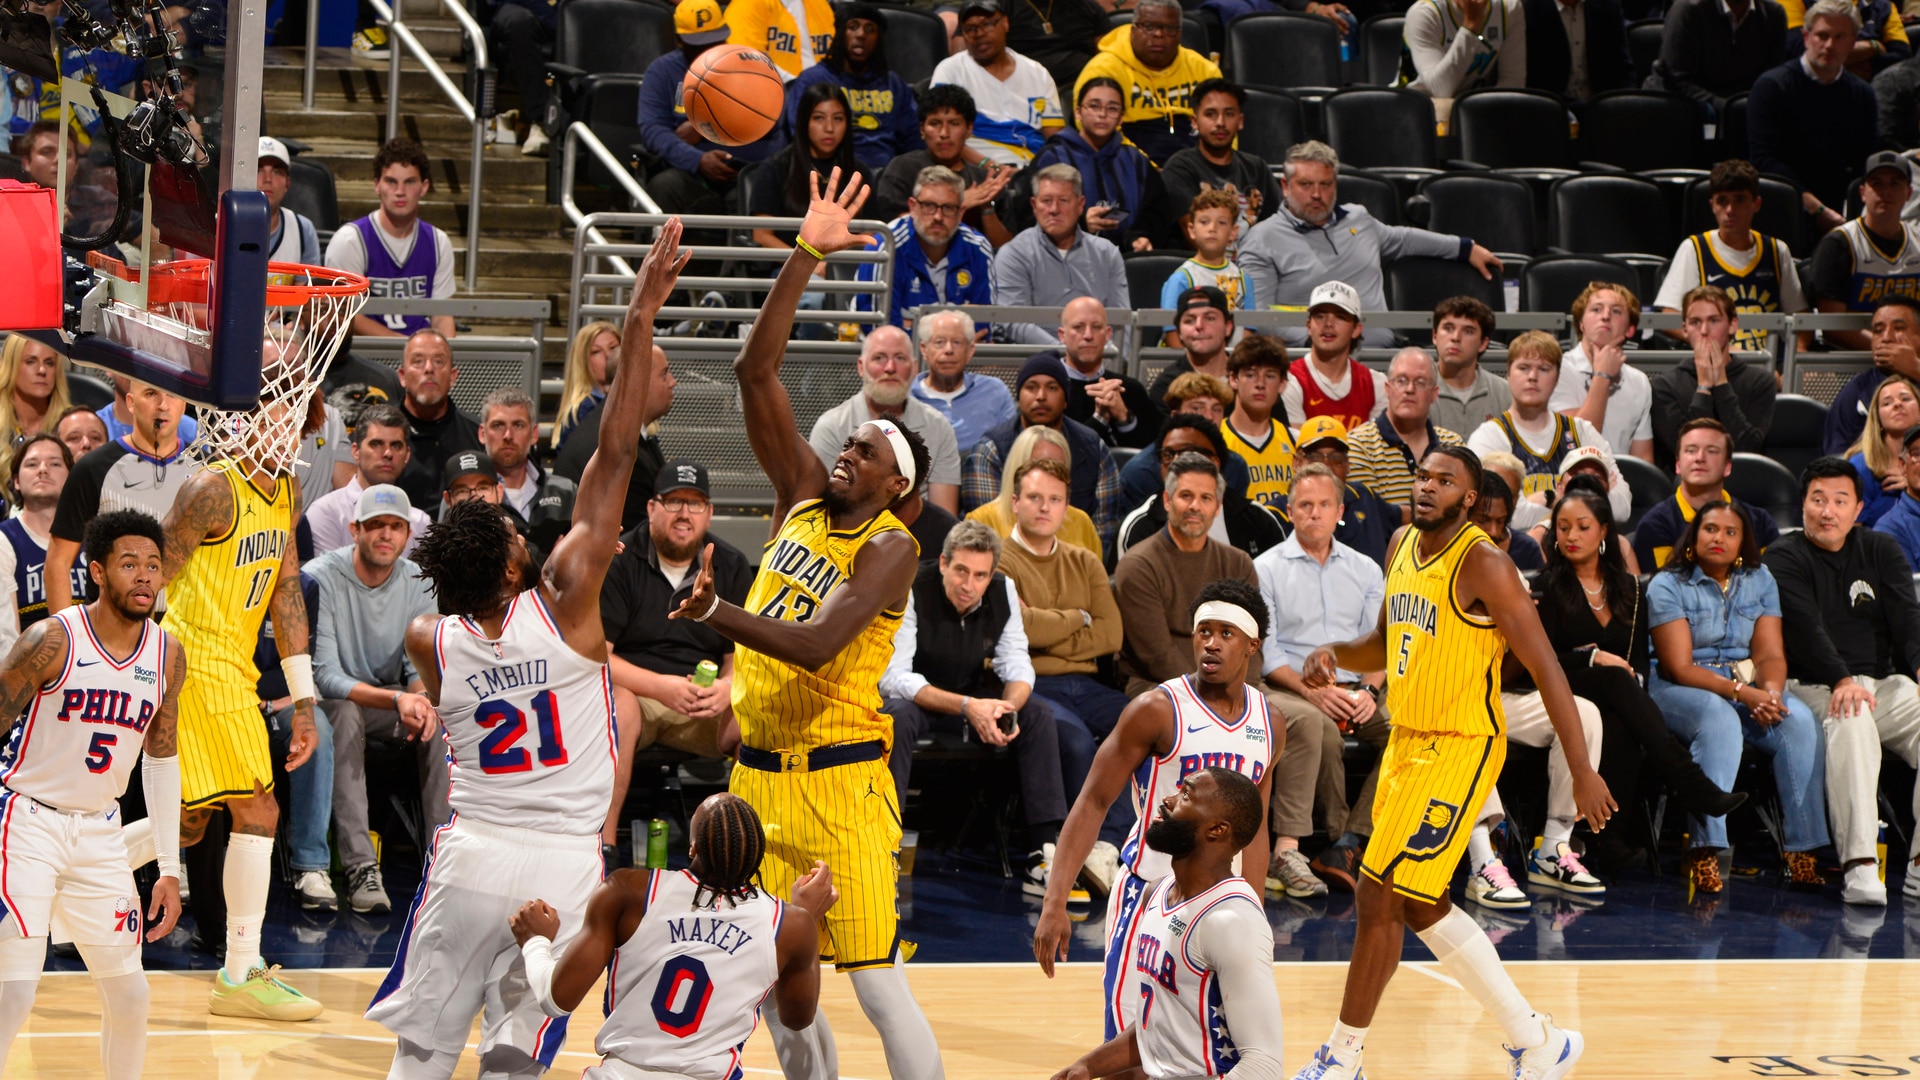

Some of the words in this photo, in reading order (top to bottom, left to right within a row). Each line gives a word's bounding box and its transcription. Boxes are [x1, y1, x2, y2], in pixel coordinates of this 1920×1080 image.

[841, 86, 894, 113] CERS
[1131, 81, 1198, 108] PACER
[368, 275, 427, 299] SAC
[1725, 284, 1778, 313] DIANA
[1249, 463, 1293, 483] DIANA
[234, 528, 287, 567] INDIAN
[245, 567, 273, 610] 10
[1388, 592, 1438, 638] INDIANA
[134, 665, 157, 678] Bloom
[1397, 632, 1413, 677] 5
[134, 674, 157, 685] energy
[465, 658, 548, 701] EMBIID
[57, 688, 155, 734] PHILA
[474, 688, 569, 775] 21
[1245, 725, 1266, 736] Bloom
[1246, 734, 1266, 743] energy
[85, 731, 118, 774] 5
[114, 908, 138, 932] 76
[667, 917, 753, 956] MAXEY
[1170, 914, 1187, 930] Bloom
[1136, 932, 1179, 996] HILA
[650, 954, 715, 1039] 0
[1140, 981, 1154, 1031] 7
[1710, 1054, 1920, 1077] SE
